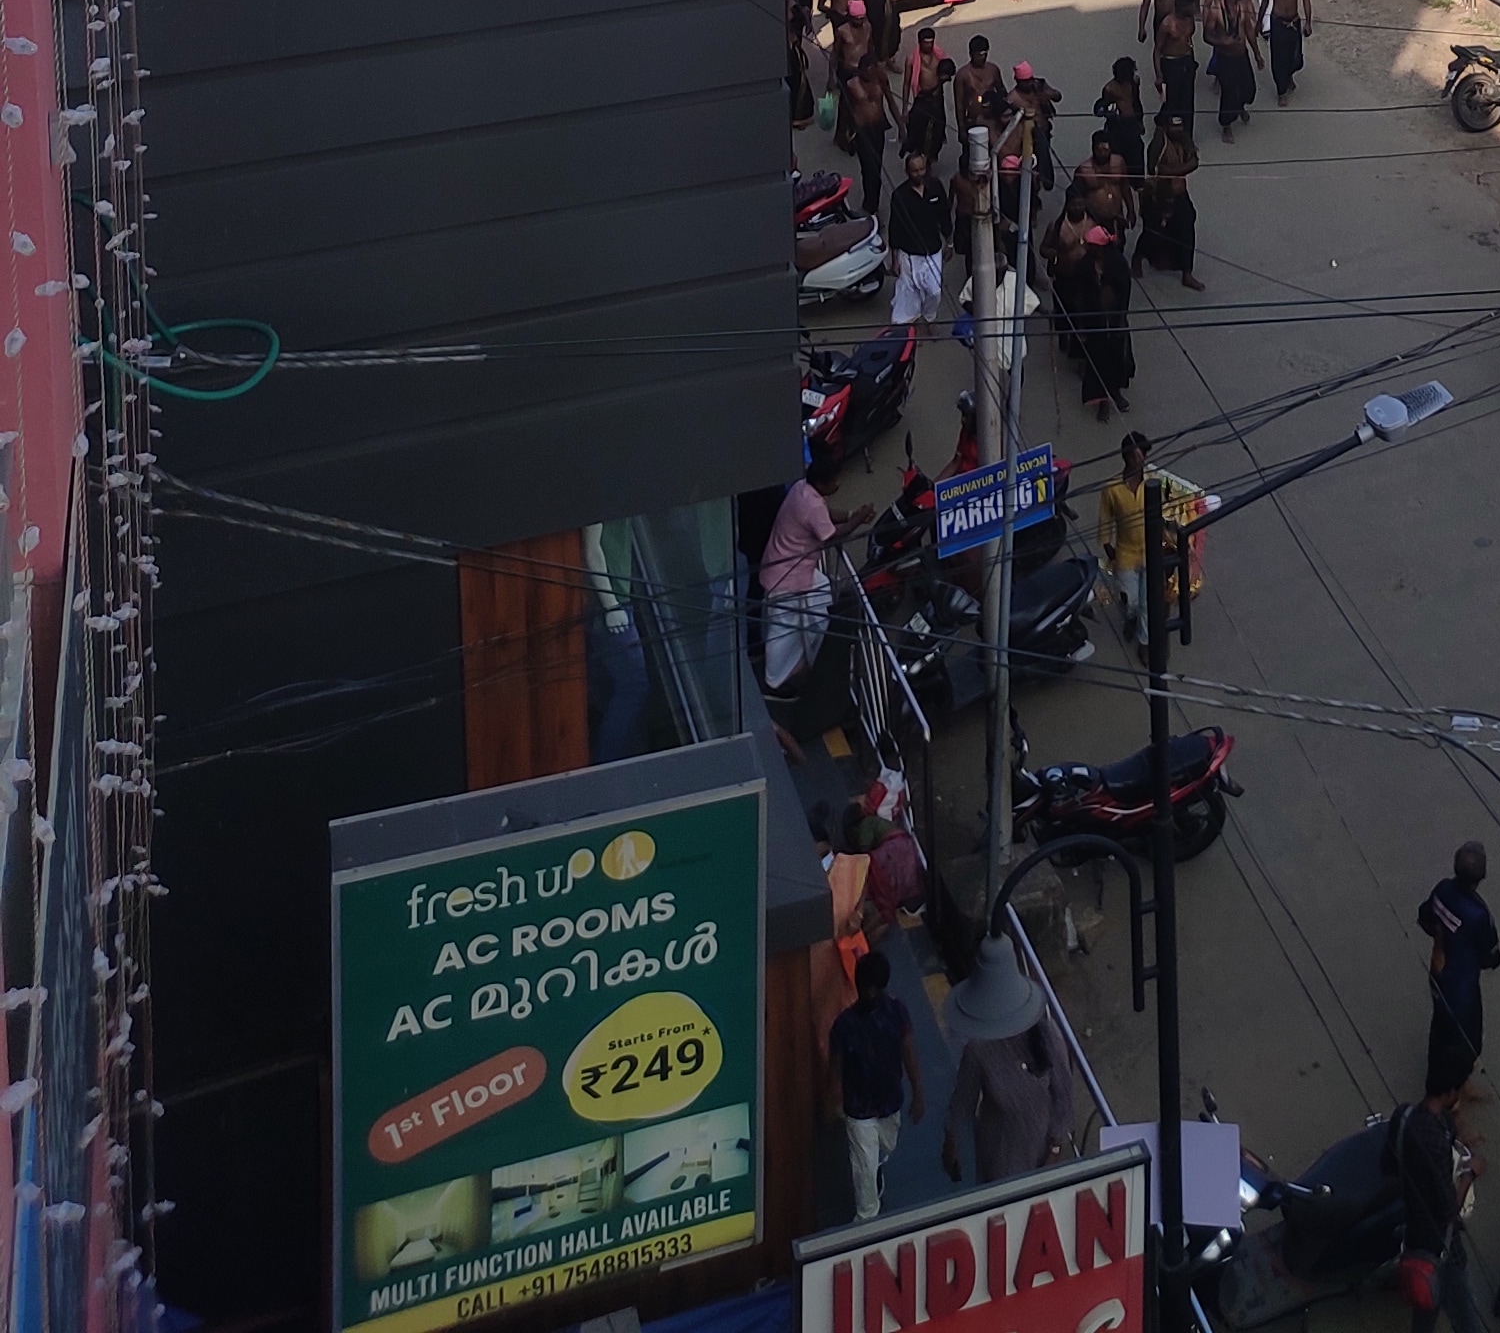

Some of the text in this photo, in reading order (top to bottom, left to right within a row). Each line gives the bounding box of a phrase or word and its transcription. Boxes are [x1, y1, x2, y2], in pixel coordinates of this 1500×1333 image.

[940, 473, 994, 502] GURUVAYUR
[407, 848, 596, 930] fresh up
[433, 891, 676, 976] AC ROOMS
[386, 920, 718, 1042] AC മുറികൾ
[608, 1021, 695, 1051] Starts From
[385, 1062, 528, 1149] 1st Floor
[370, 1188, 732, 1316] MULTI FUNCTION HALL AVAILABLE
[832, 1178, 1127, 1333] INDIAN
[456, 1288, 511, 1319] CALL
